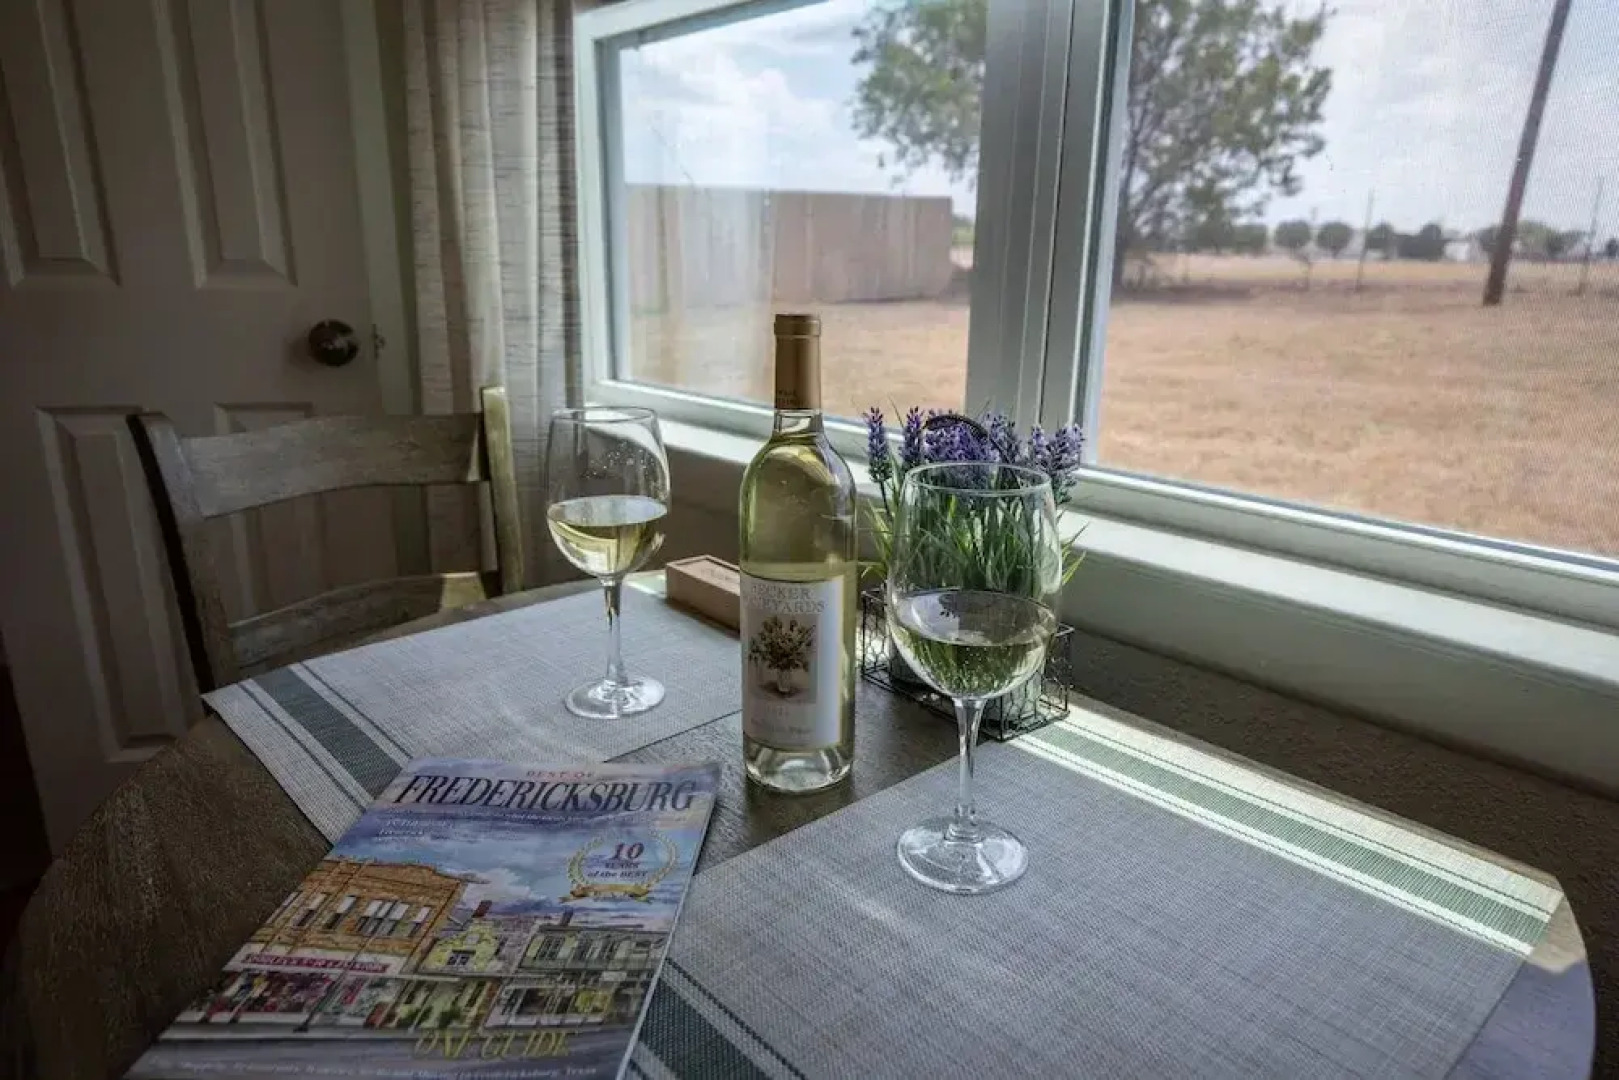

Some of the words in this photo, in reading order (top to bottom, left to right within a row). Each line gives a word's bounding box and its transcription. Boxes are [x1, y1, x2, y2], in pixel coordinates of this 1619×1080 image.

[394, 774, 697, 812] FREDERICKSBURG
[611, 841, 645, 861] 10
[600, 870, 618, 878] the
